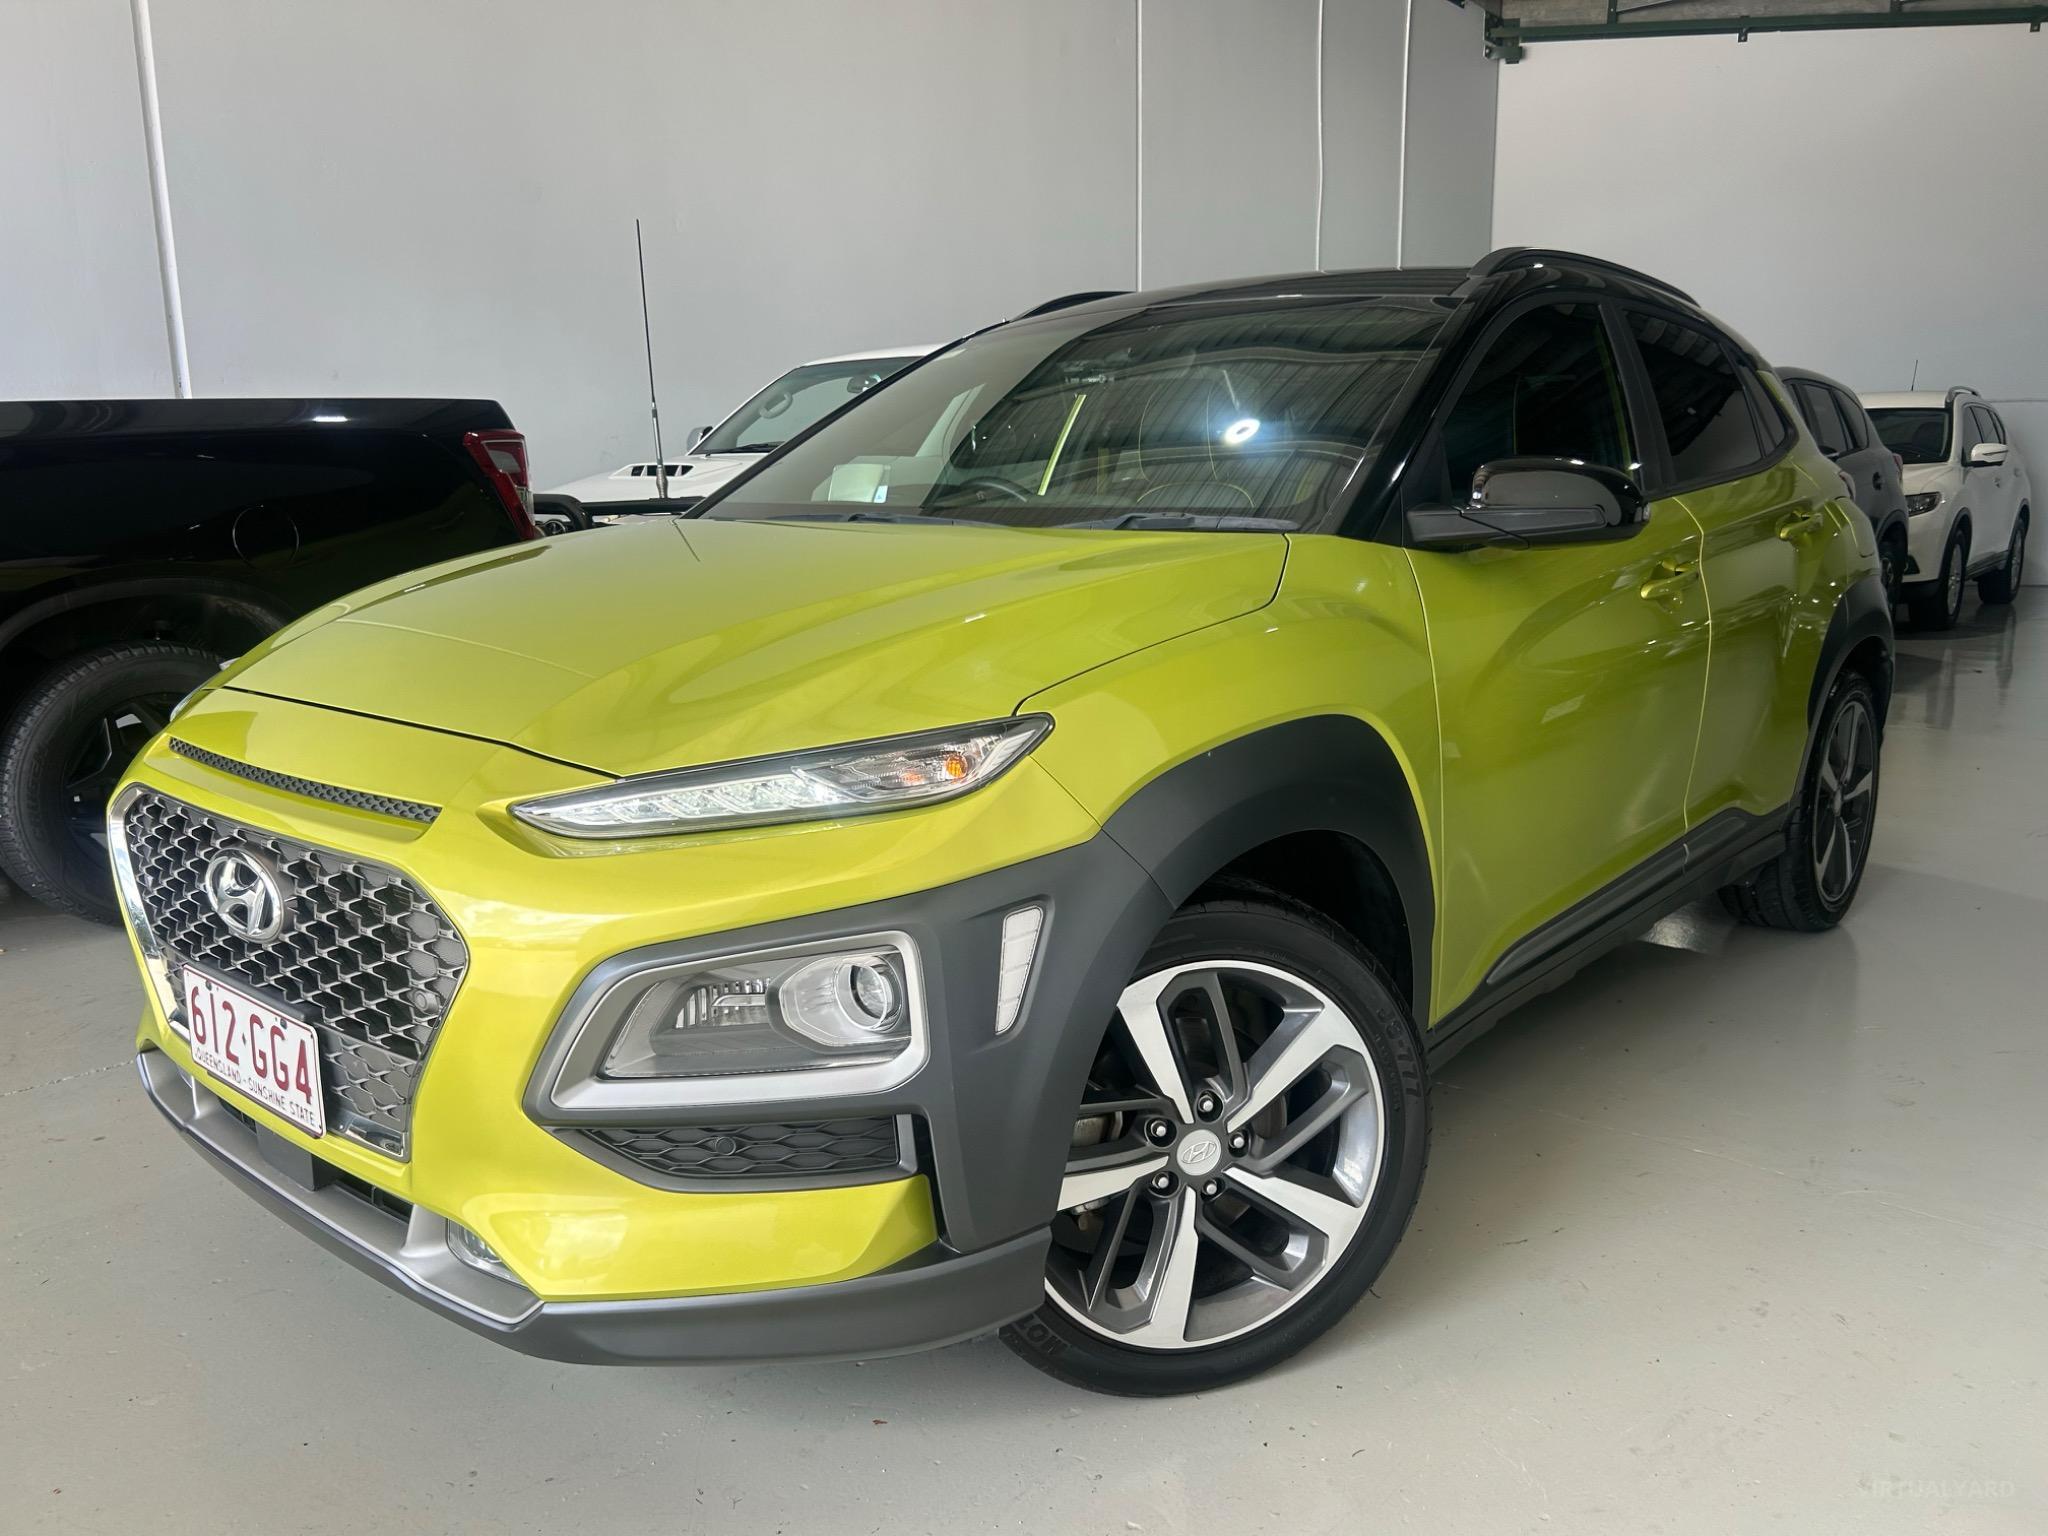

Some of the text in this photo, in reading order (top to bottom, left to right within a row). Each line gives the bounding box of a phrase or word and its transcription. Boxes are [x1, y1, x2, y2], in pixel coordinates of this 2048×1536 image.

[195, 1047, 316, 1127] QUEENSLAND SUNSHINE STATE
